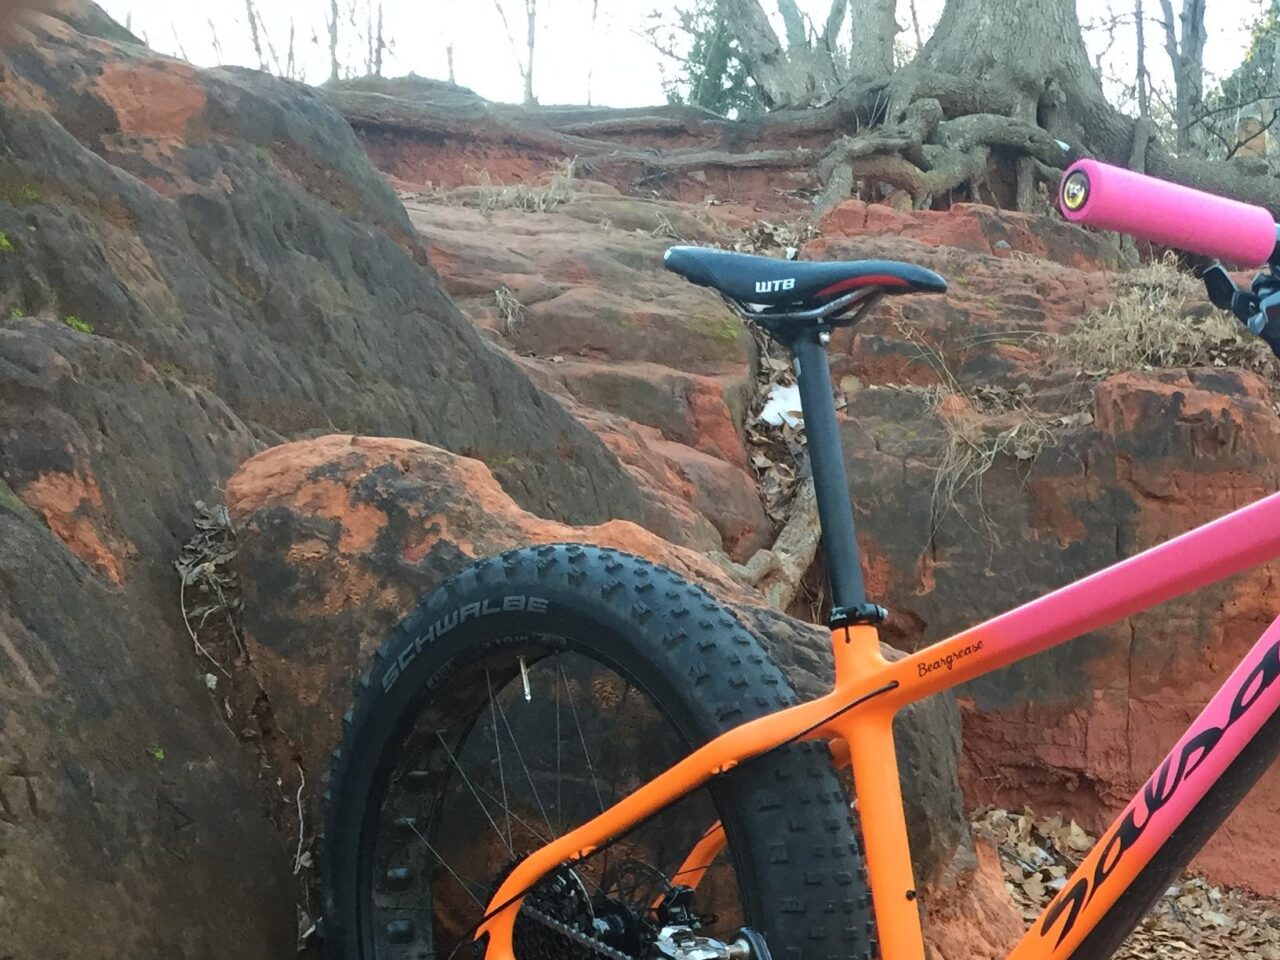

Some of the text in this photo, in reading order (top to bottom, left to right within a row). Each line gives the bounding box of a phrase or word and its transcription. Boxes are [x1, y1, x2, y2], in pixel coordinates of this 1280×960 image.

[755, 278, 795, 293] WTB
[381, 595, 550, 693] SCHWALBE
[917, 640, 983, 678] Beargrease
